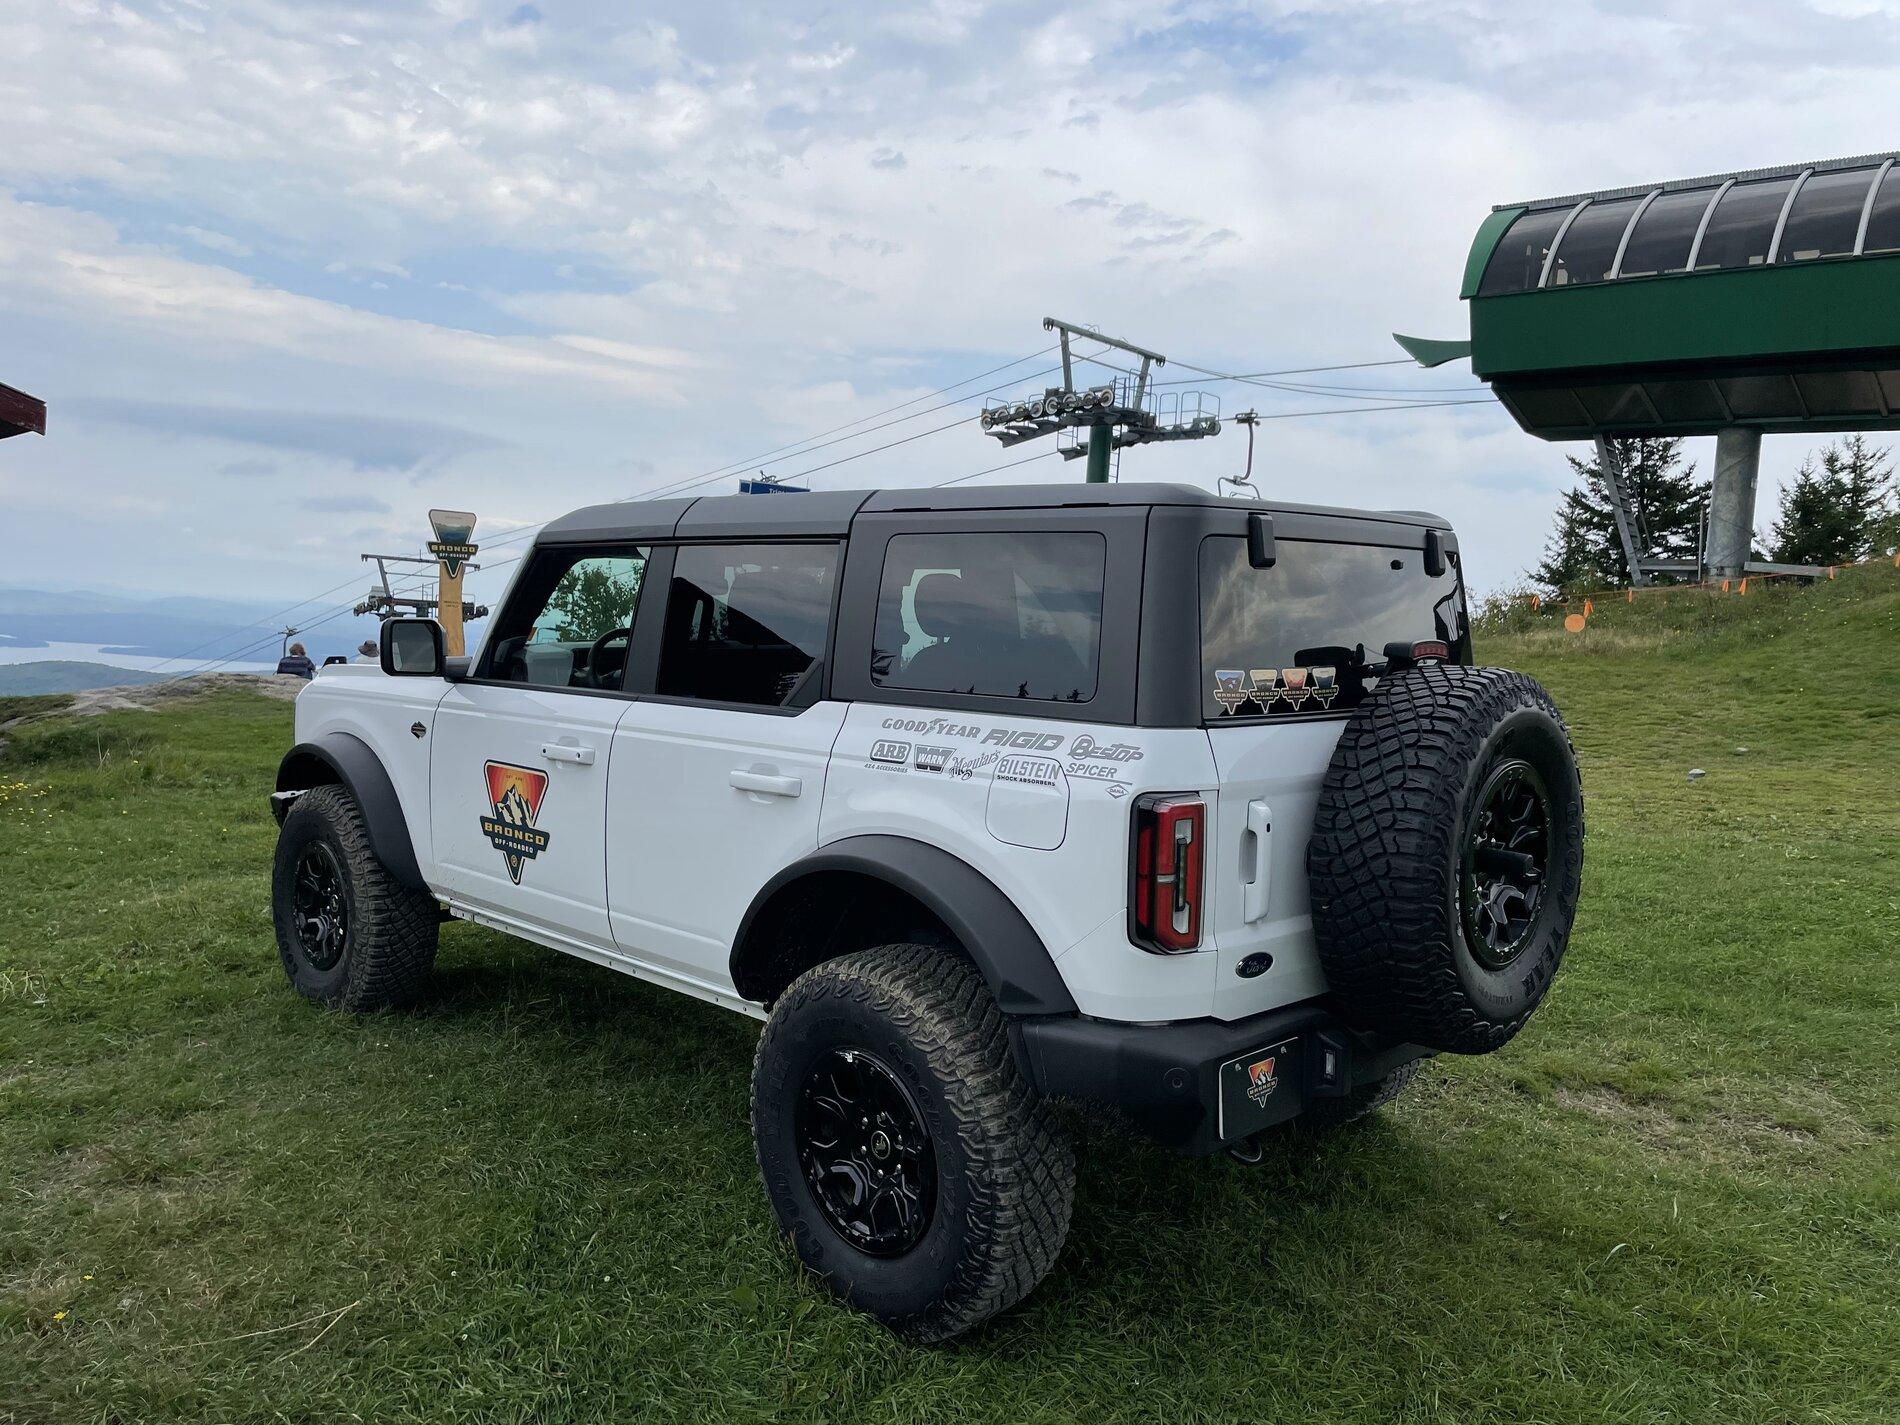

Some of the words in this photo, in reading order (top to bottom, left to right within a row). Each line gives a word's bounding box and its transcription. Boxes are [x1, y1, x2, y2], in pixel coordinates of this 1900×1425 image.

[431, 544, 476, 553] BRONCO
[881, 718, 981, 738] GOODYEAR
[980, 728, 1065, 751] RIGID
[873, 742, 908, 760] ARB
[917, 752, 945, 765] WARN
[998, 759, 1061, 780] BILSTEIN
[1065, 762, 1118, 779] SPICER
[997, 774, 1018, 782] SHOCK
[1018, 777, 1056, 787] ABSORBERS
[485, 822, 545, 846] BRONCO
